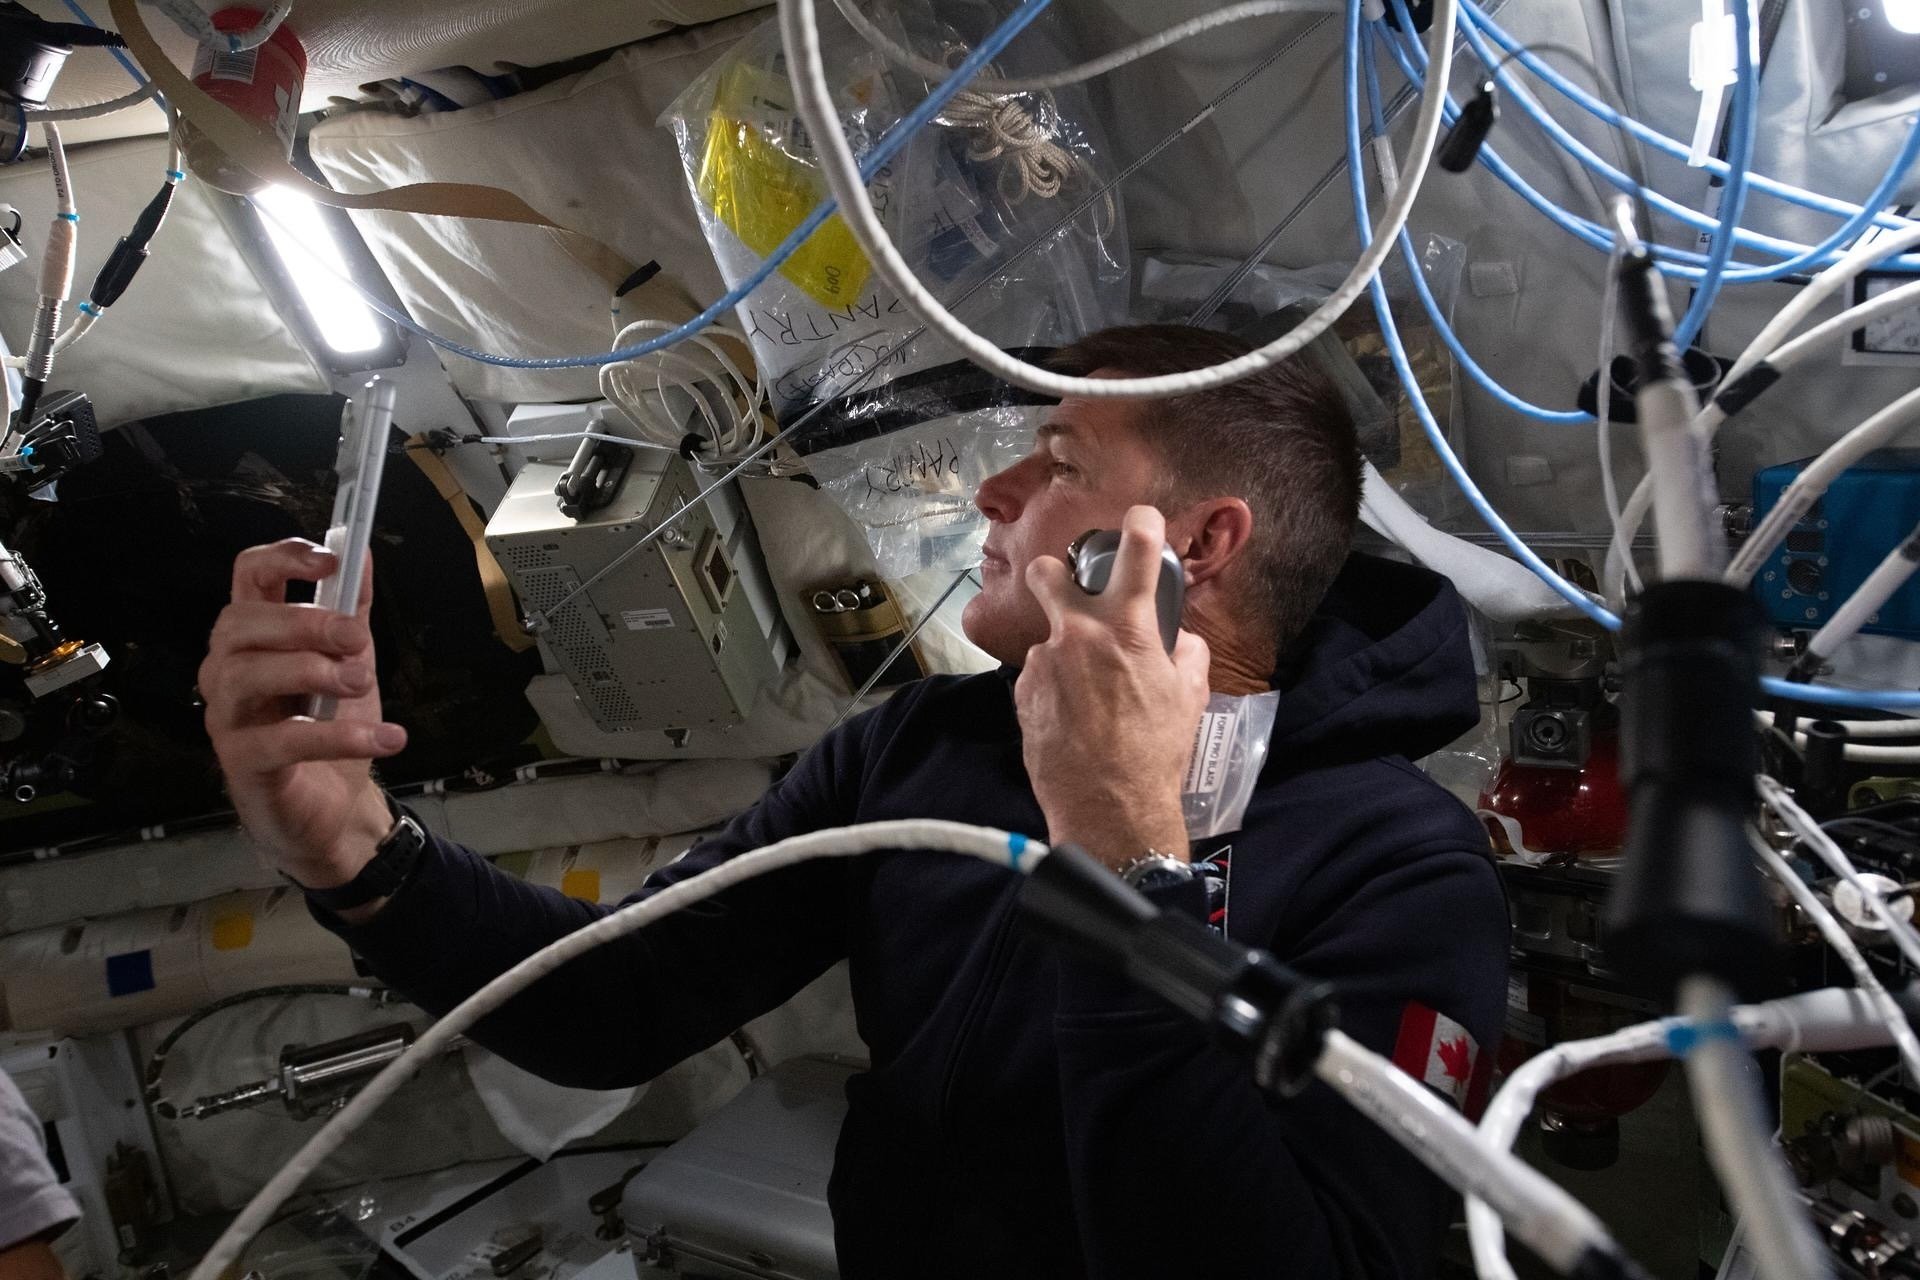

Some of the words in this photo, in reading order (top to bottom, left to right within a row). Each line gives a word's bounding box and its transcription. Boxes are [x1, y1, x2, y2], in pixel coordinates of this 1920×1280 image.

[749, 294, 908, 346] PANTRY
[1214, 716, 1227, 740] FORTE
[1209, 742, 1222, 759] PRO
[1205, 760, 1217, 786] BLADE
